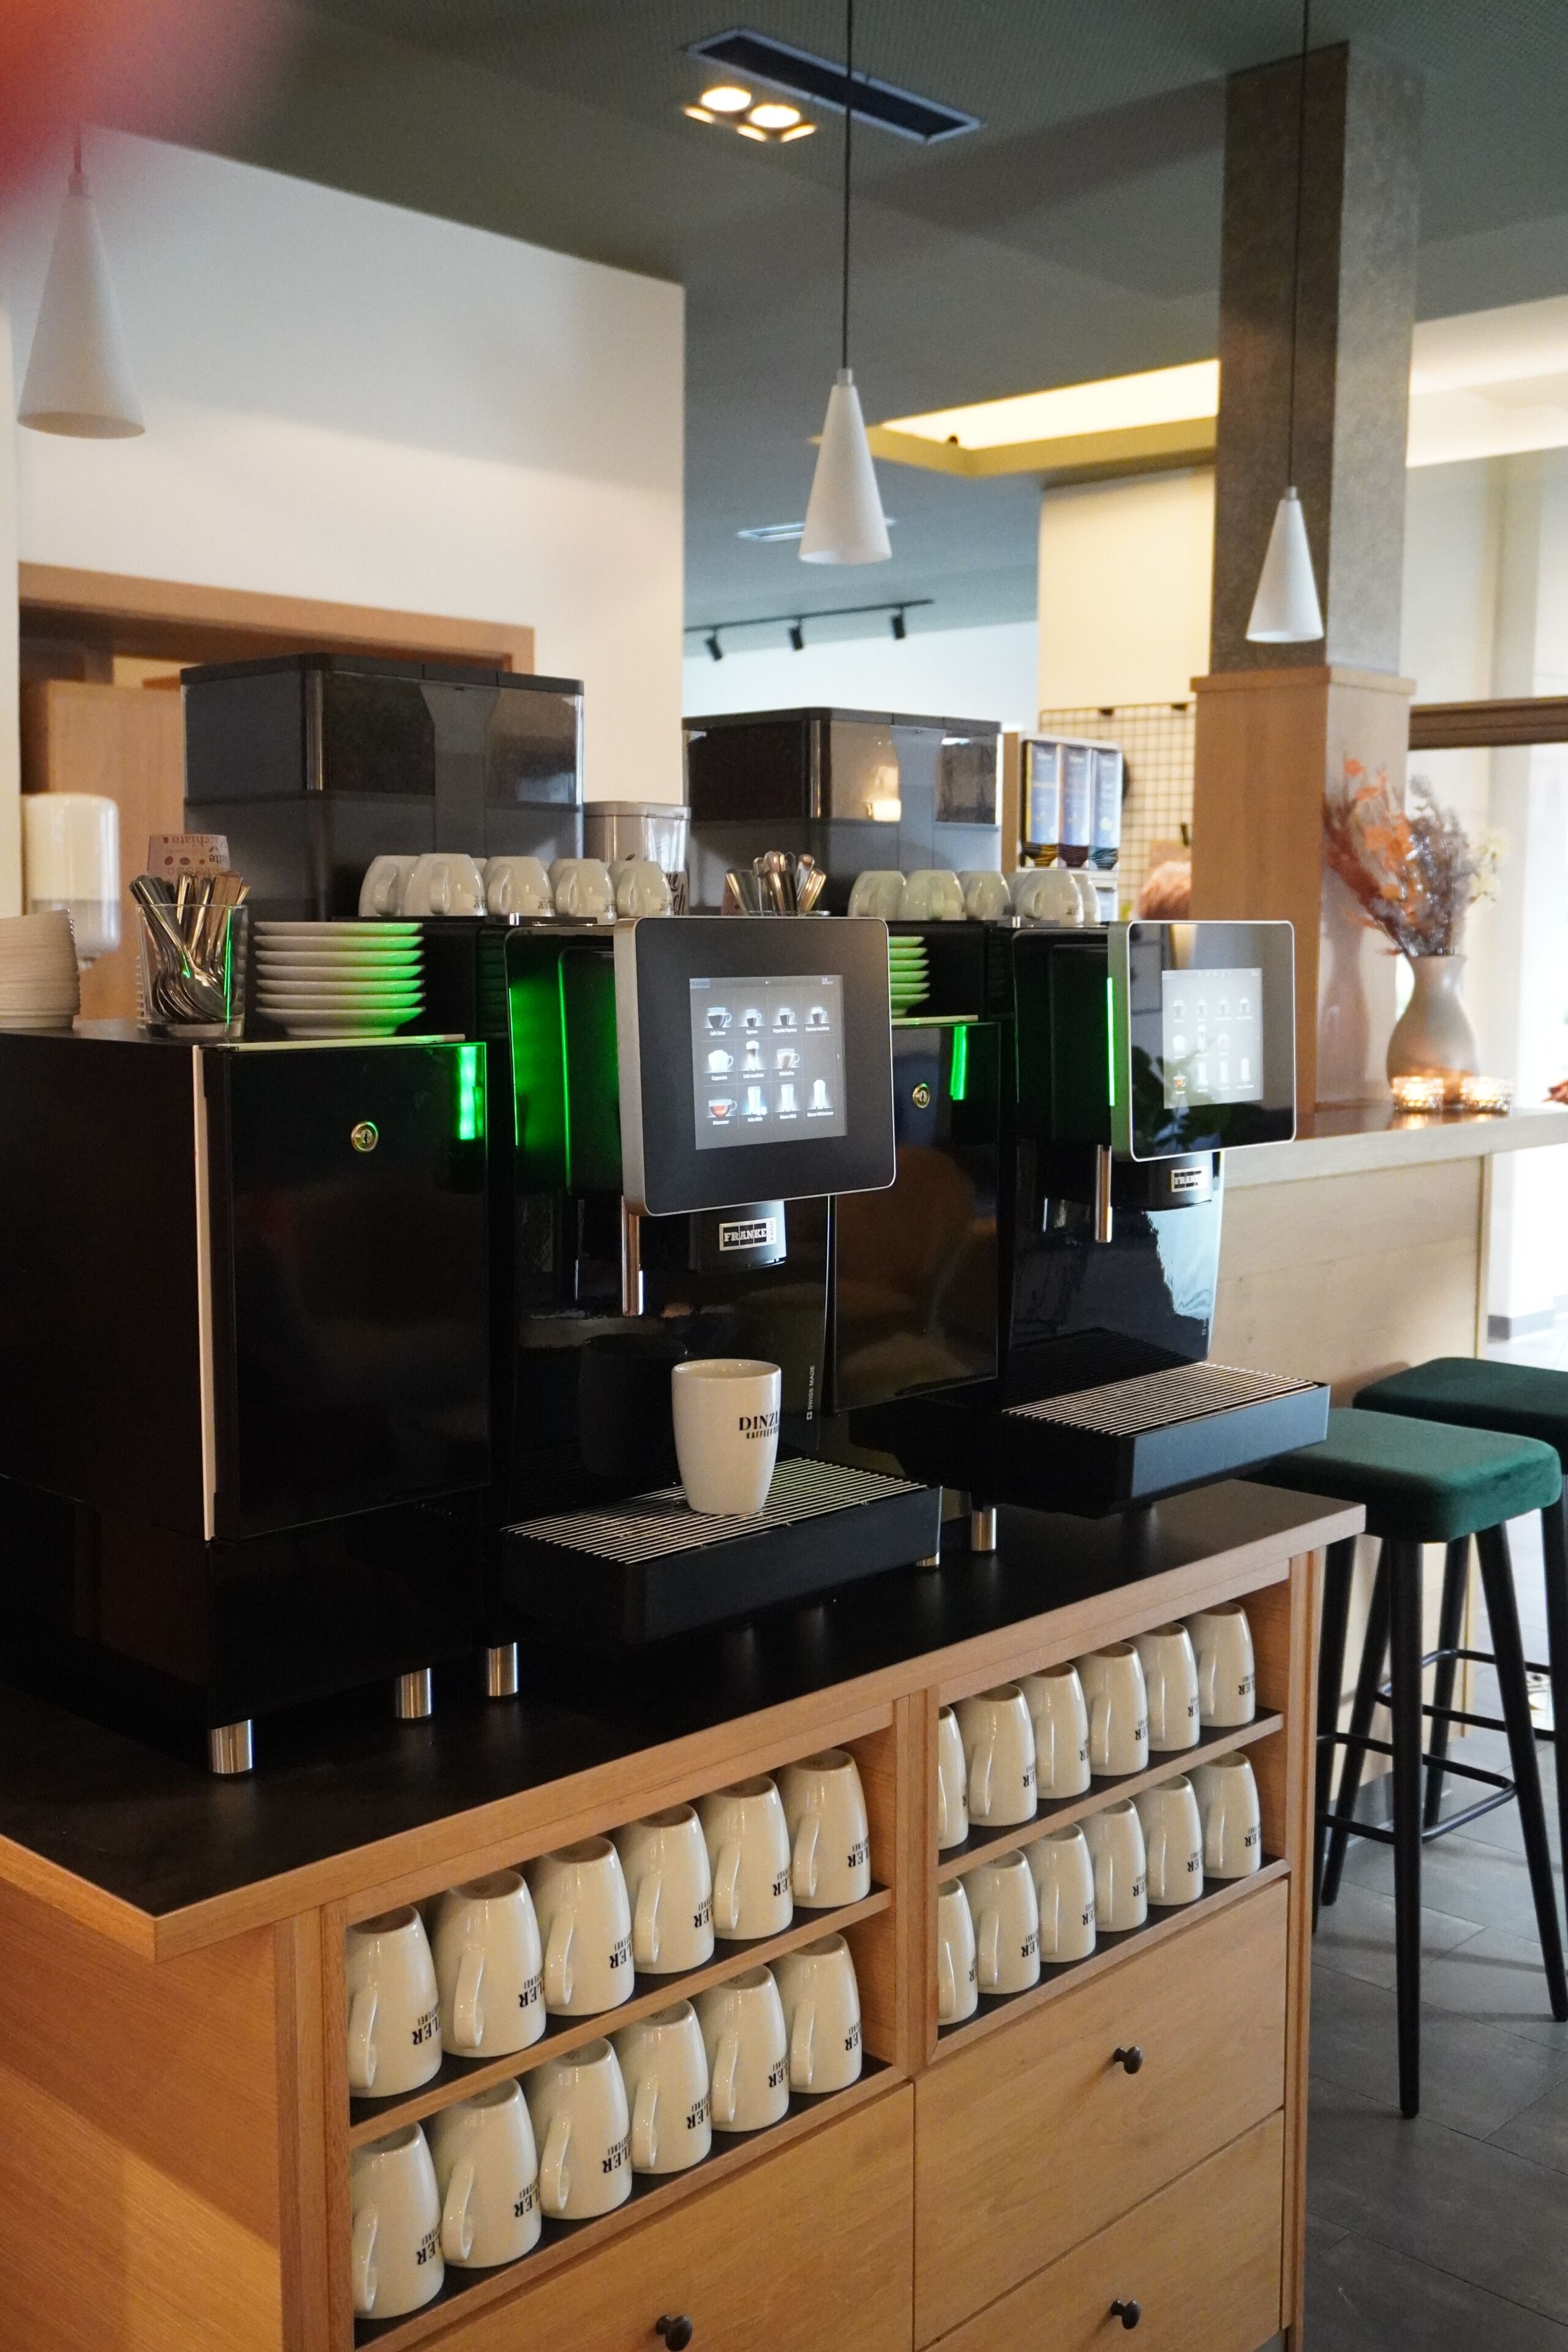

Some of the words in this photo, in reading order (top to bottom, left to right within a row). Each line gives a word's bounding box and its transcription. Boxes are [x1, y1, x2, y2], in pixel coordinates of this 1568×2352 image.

[1174, 1175, 1200, 1185] FRAN
[723, 1228, 766, 1242] FRANKE
[609, 1942, 632, 1969] LER
[518, 1981, 544, 2008] LER
[412, 2016, 439, 2045] LER
[687, 2103, 710, 2130] LER
[602, 2146, 630, 2173] LER
[514, 2188, 539, 2217] LER
